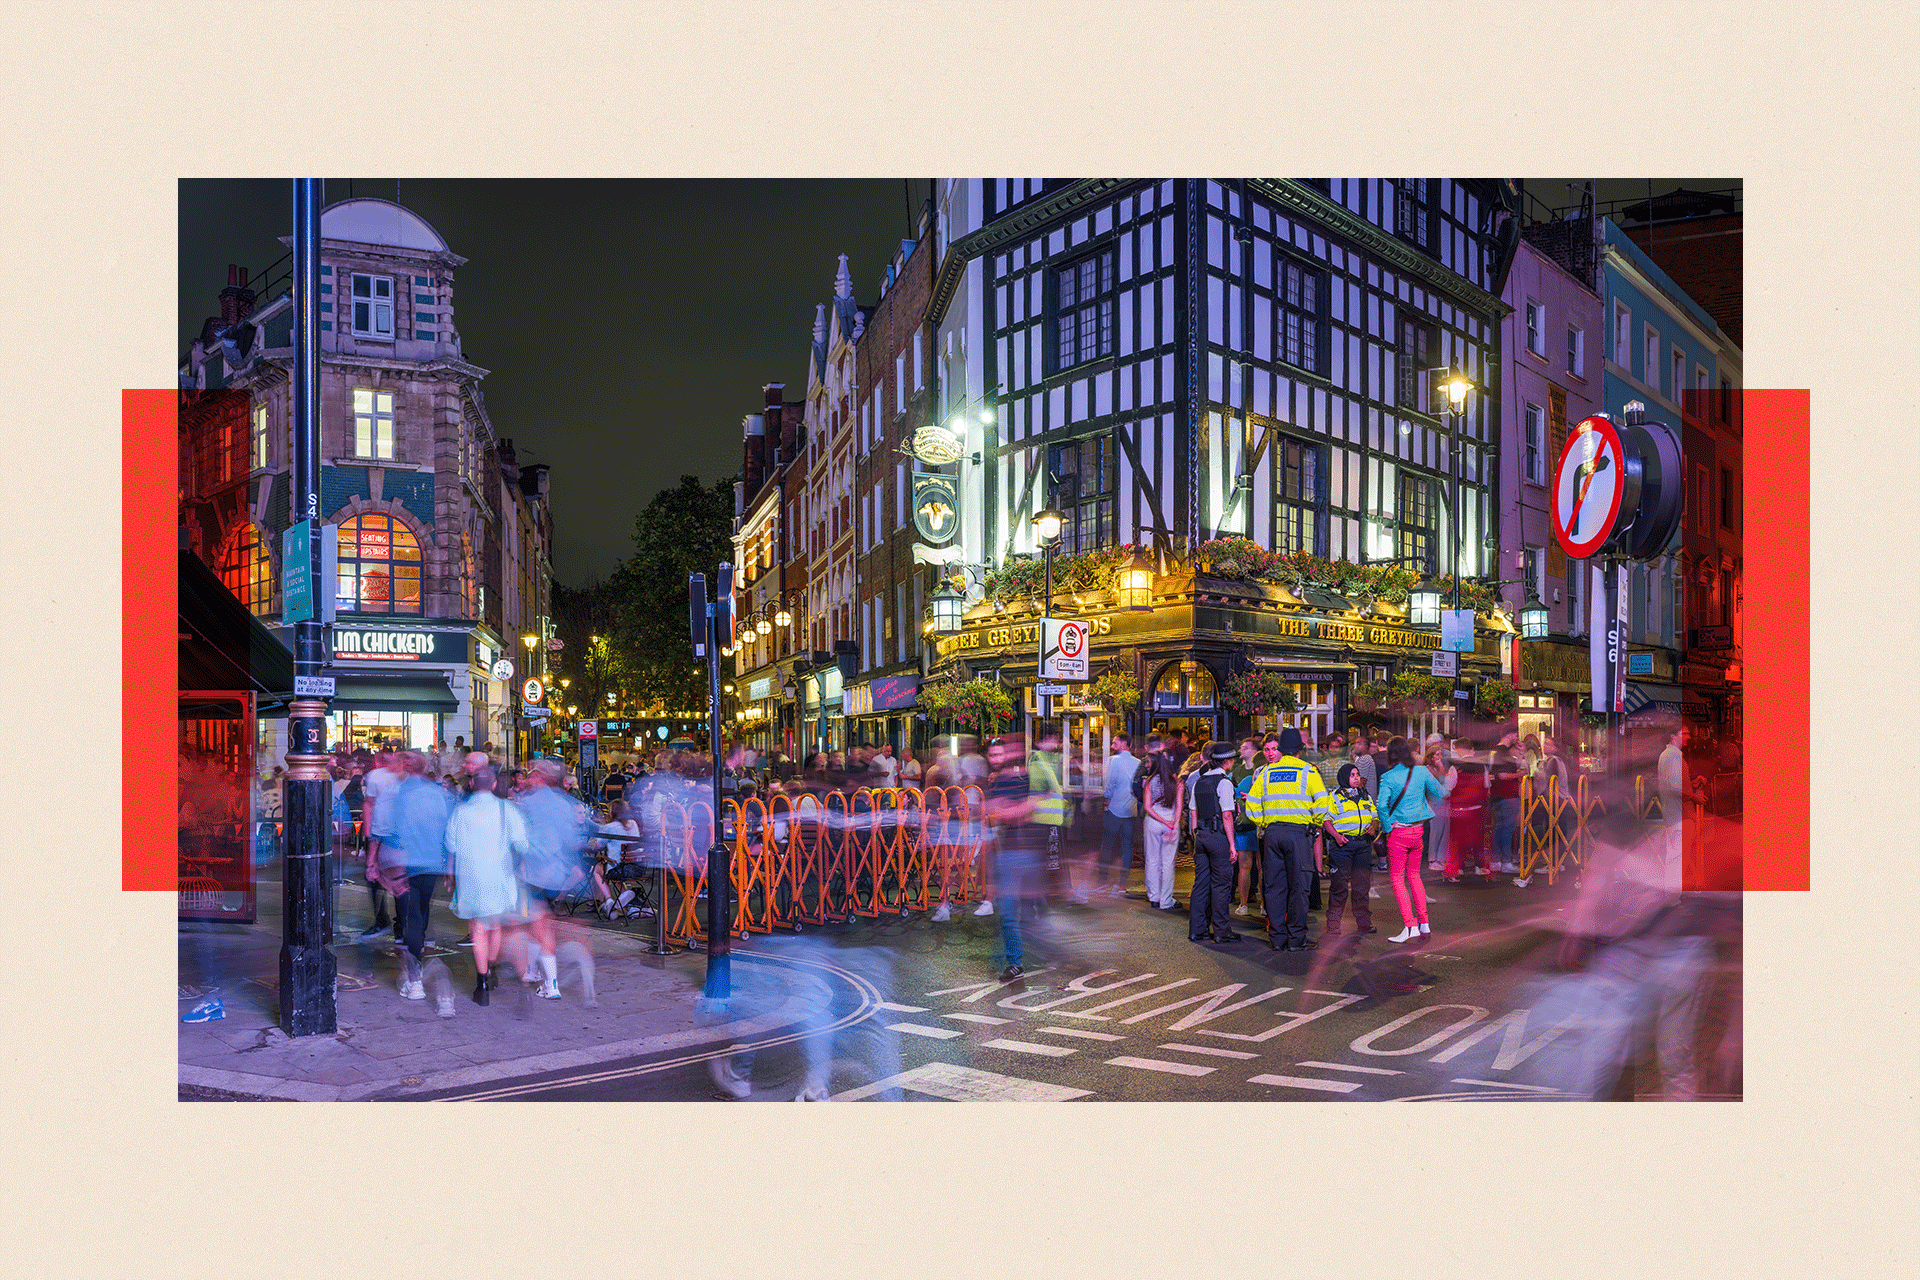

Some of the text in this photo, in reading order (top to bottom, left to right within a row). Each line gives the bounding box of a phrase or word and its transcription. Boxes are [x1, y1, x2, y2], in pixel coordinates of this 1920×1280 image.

[1278, 617, 1310, 637] THE
[1317, 622, 1365, 643] THREE
[362, 631, 435, 655] CHICKENS
[876, 679, 898, 698] Tattoo
[885, 687, 916, 707] Piercing
[924, 967, 1369, 1043] ENTRY
